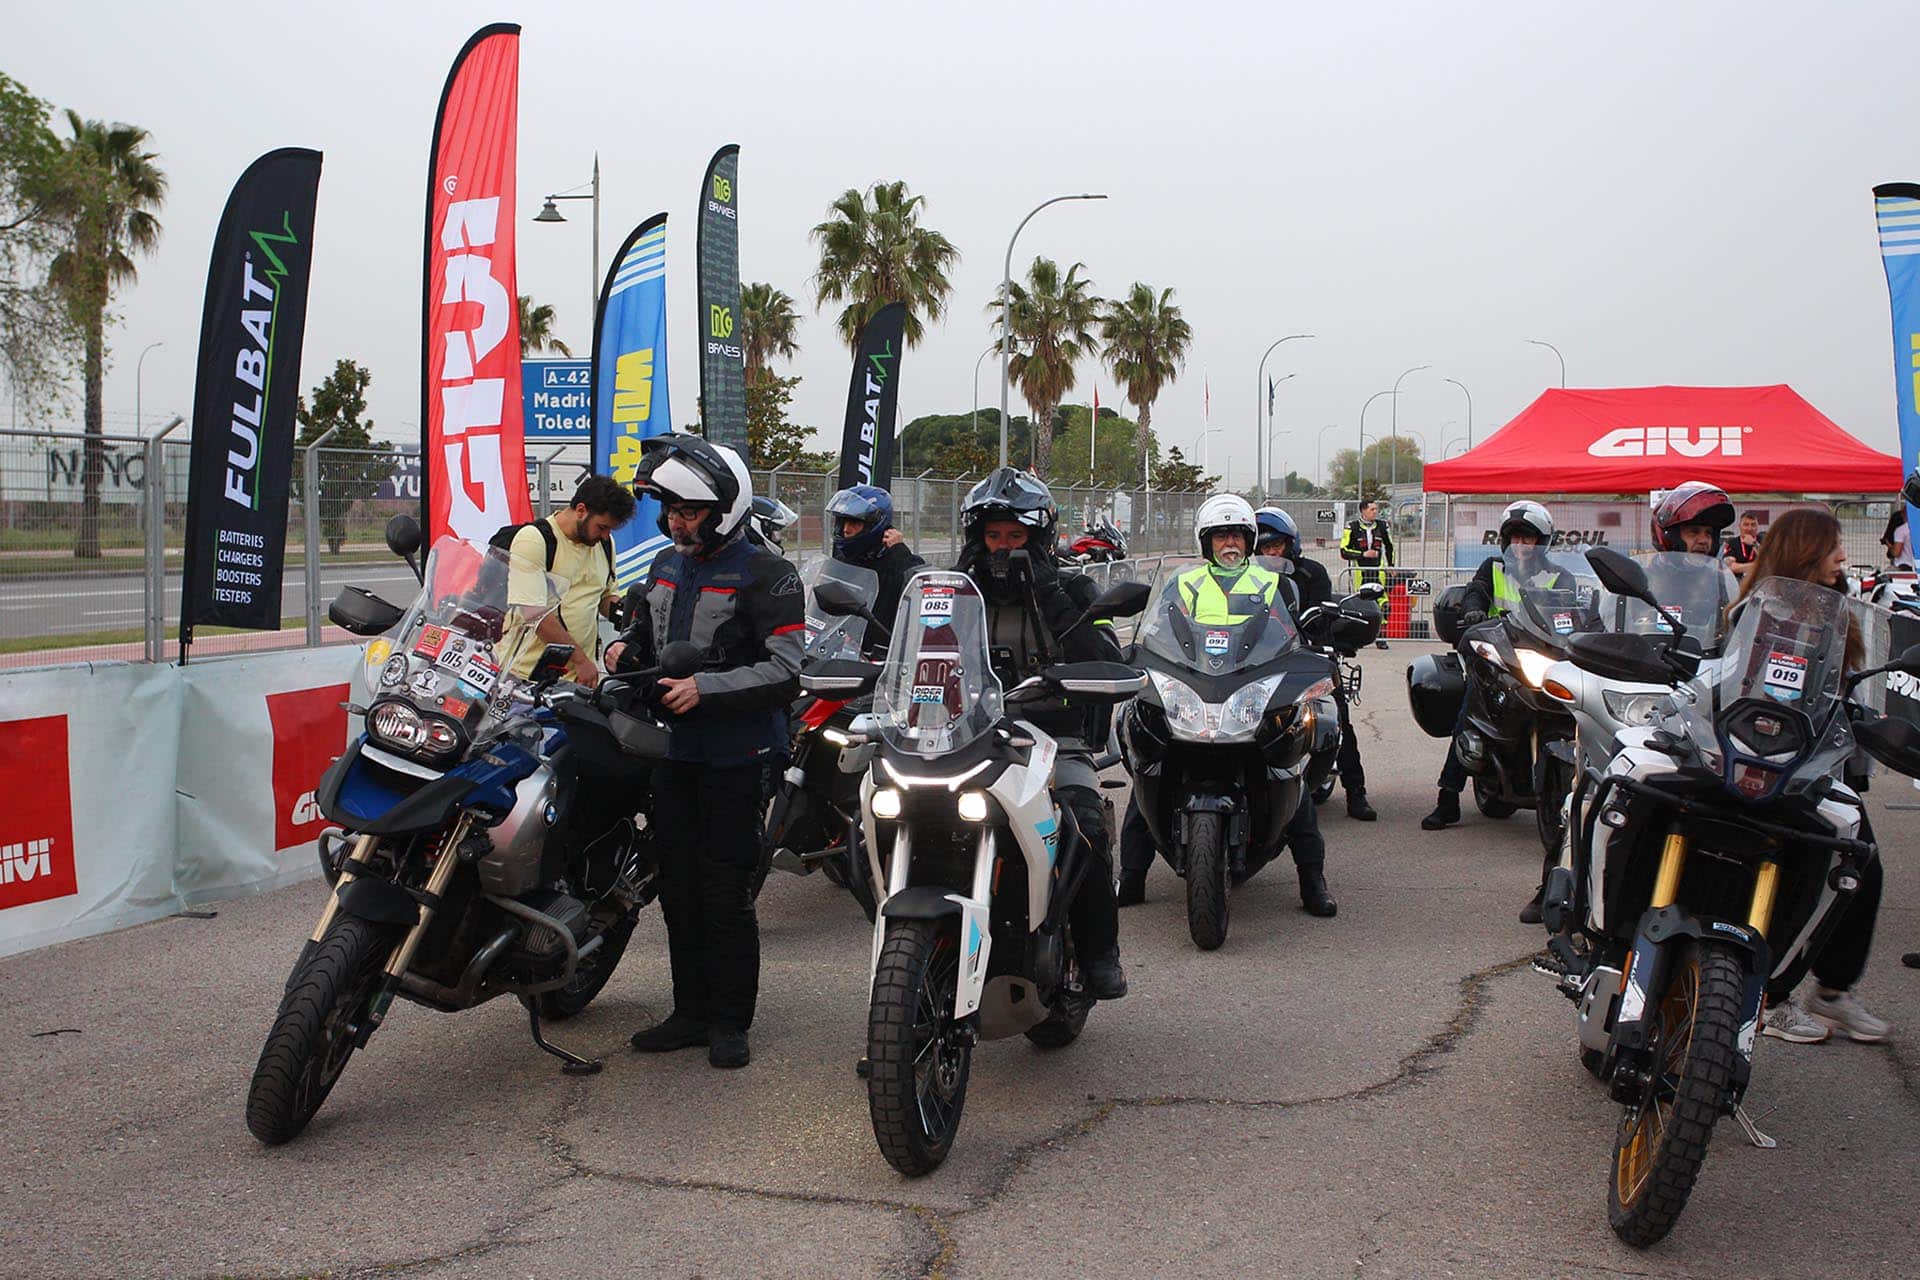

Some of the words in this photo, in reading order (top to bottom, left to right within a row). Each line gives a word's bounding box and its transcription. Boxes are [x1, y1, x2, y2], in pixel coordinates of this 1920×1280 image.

[225, 261, 274, 509] FULBAT
[1588, 426, 1743, 457] GIVI
[219, 530, 264, 548] BATTERIES
[218, 549, 263, 567] CHARGERS
[217, 568, 262, 586] BOOSTERS
[215, 588, 252, 604] TESTERS
[924, 601, 949, 611] 085
[467, 669, 490, 686] 091
[1772, 668, 1798, 682] 019
[0, 838, 51, 885] IVI
